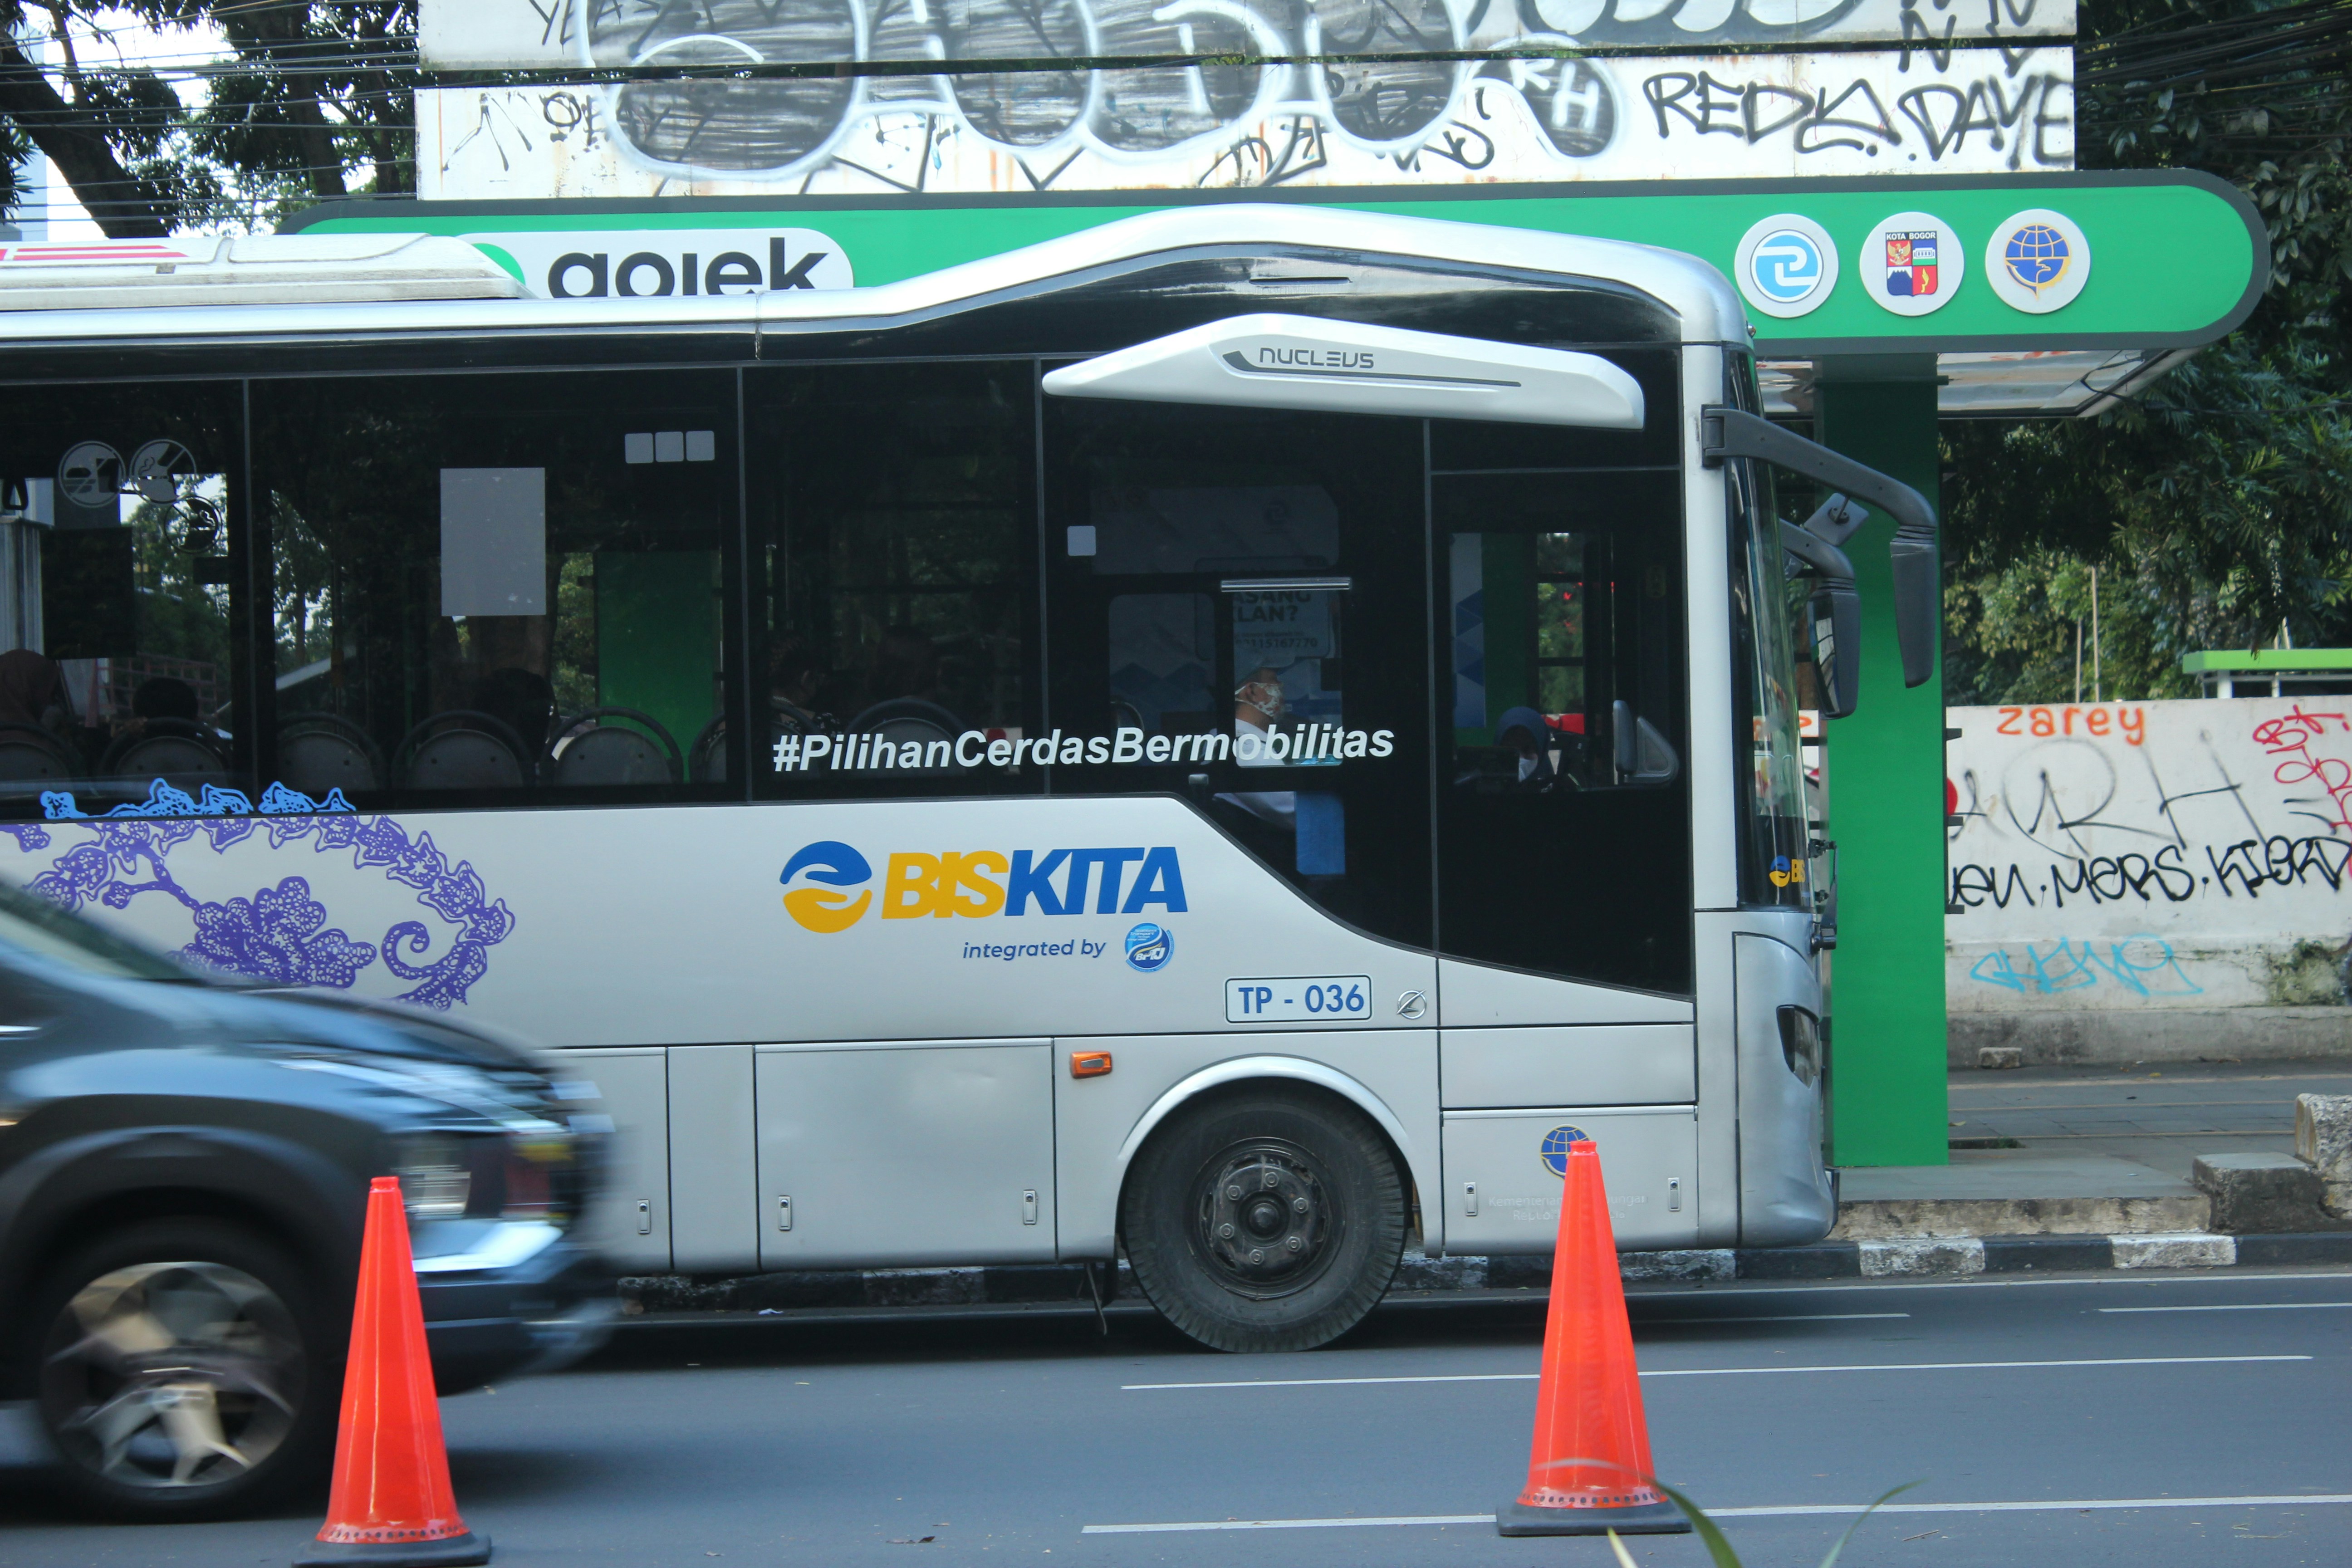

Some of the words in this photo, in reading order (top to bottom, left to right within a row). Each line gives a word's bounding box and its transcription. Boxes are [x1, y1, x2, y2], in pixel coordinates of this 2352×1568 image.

[1908, 231, 1936, 240] BOGOR
[1259, 347, 1375, 369] NUCLEUS
[1996, 705, 2147, 746] zarey
[773, 724, 1396, 772] #PilihanCerdasBermobilitas
[881, 846, 1189, 919] BISKITA
[962, 939, 1074, 961] integrated
[1080, 939, 1107, 958] by
[1238, 986, 1273, 1014] TP
[1304, 984, 1365, 1013] 036
